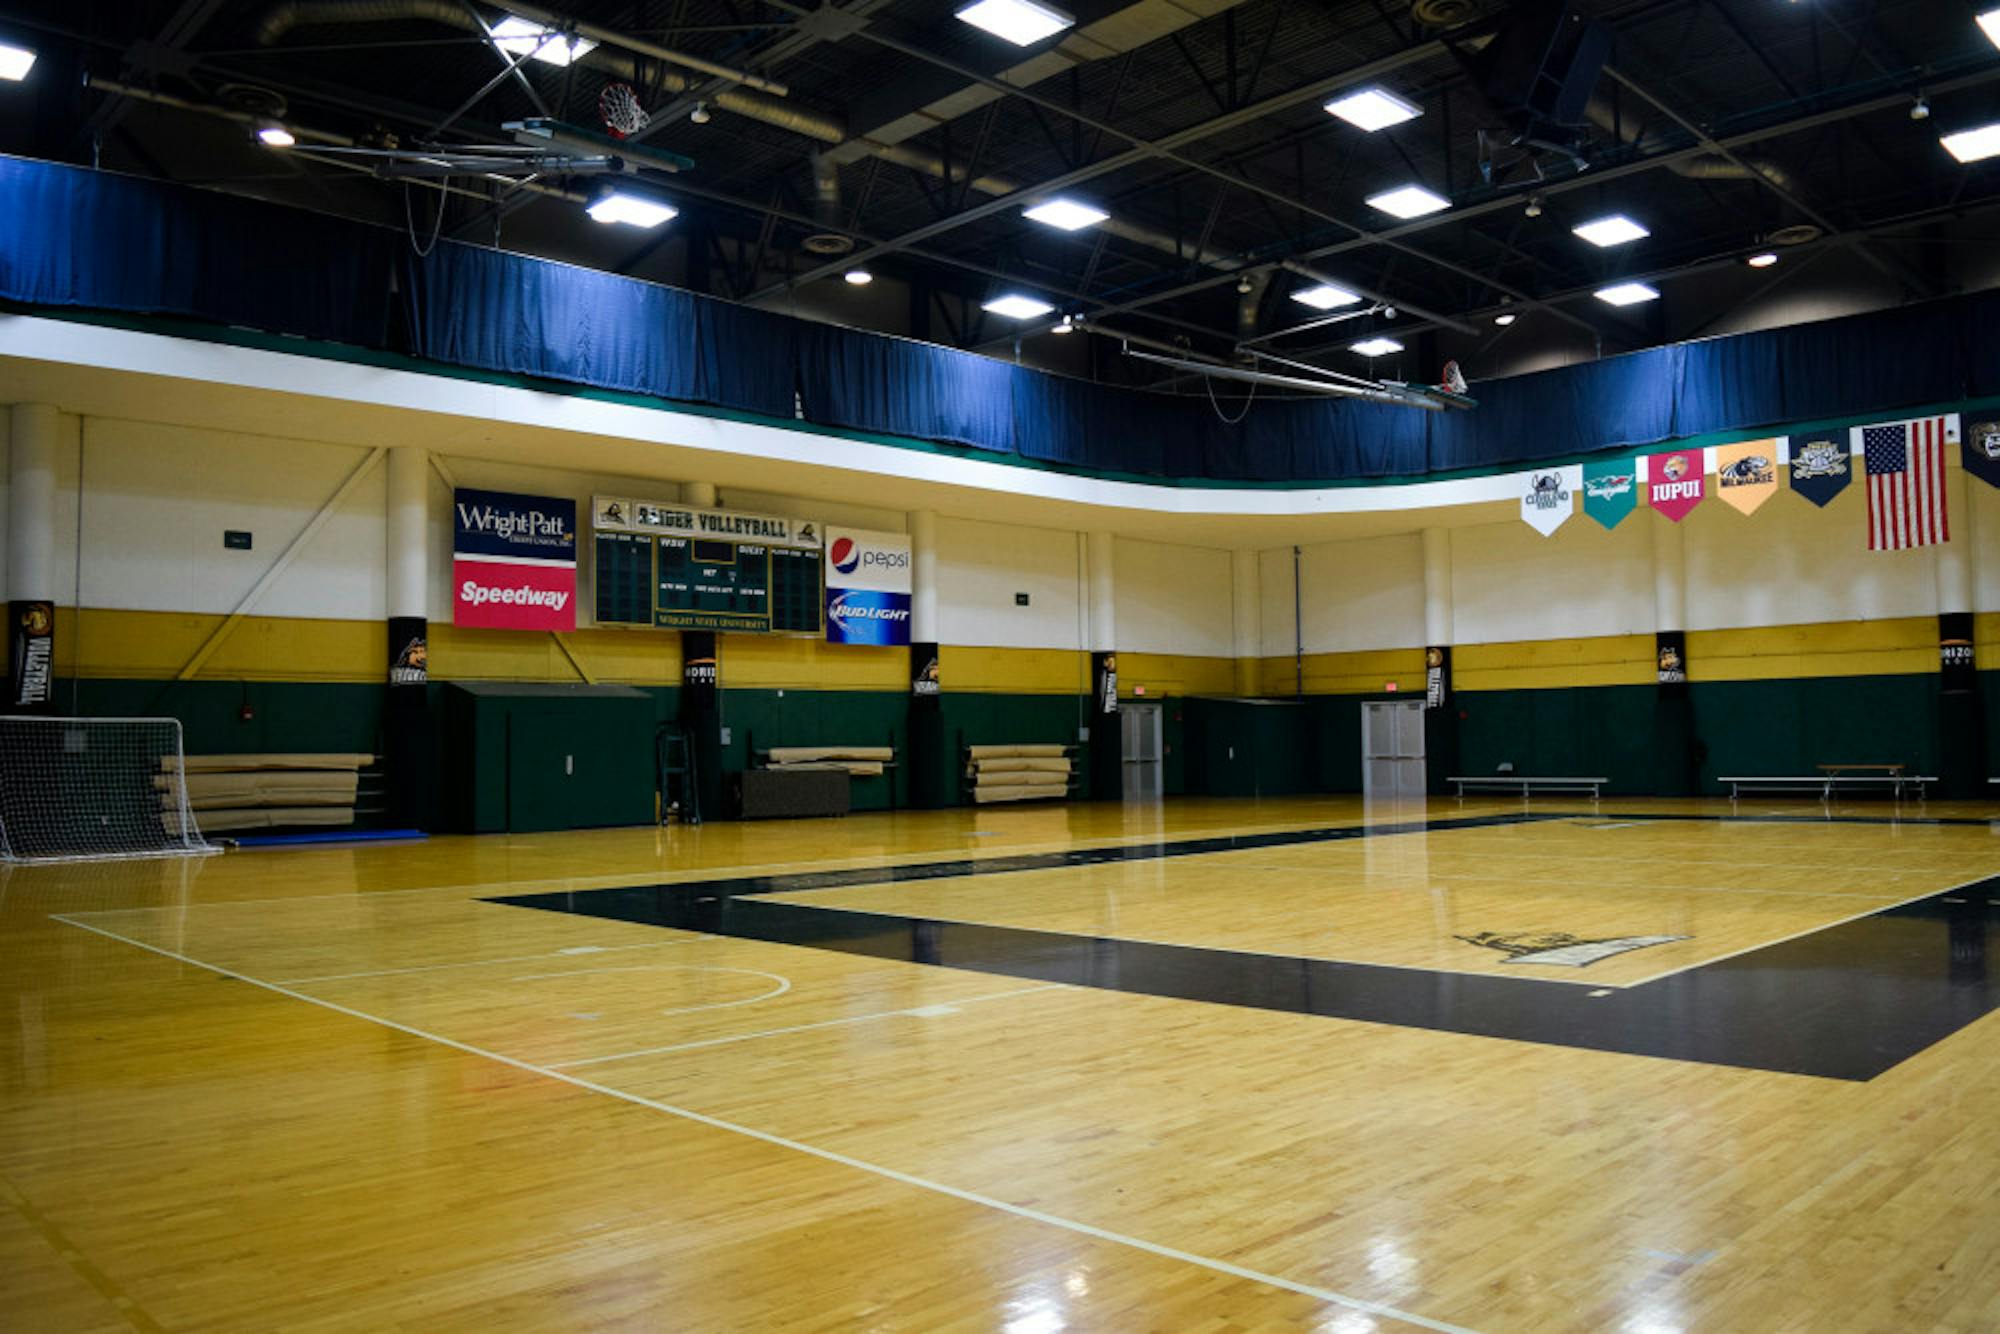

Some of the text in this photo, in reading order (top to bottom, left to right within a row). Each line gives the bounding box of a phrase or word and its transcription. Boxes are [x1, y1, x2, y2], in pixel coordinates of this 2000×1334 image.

[1652, 480, 1700, 502] IUPUI
[1720, 472, 1774, 488] MILWAUKEE
[457, 503, 564, 538] Wright-Patt
[699, 514, 786, 538] VOLLEYBALL
[863, 551, 909, 569] pepsi
[461, 580, 569, 611] Speedway
[836, 605, 910, 620] BUD LIGHT
